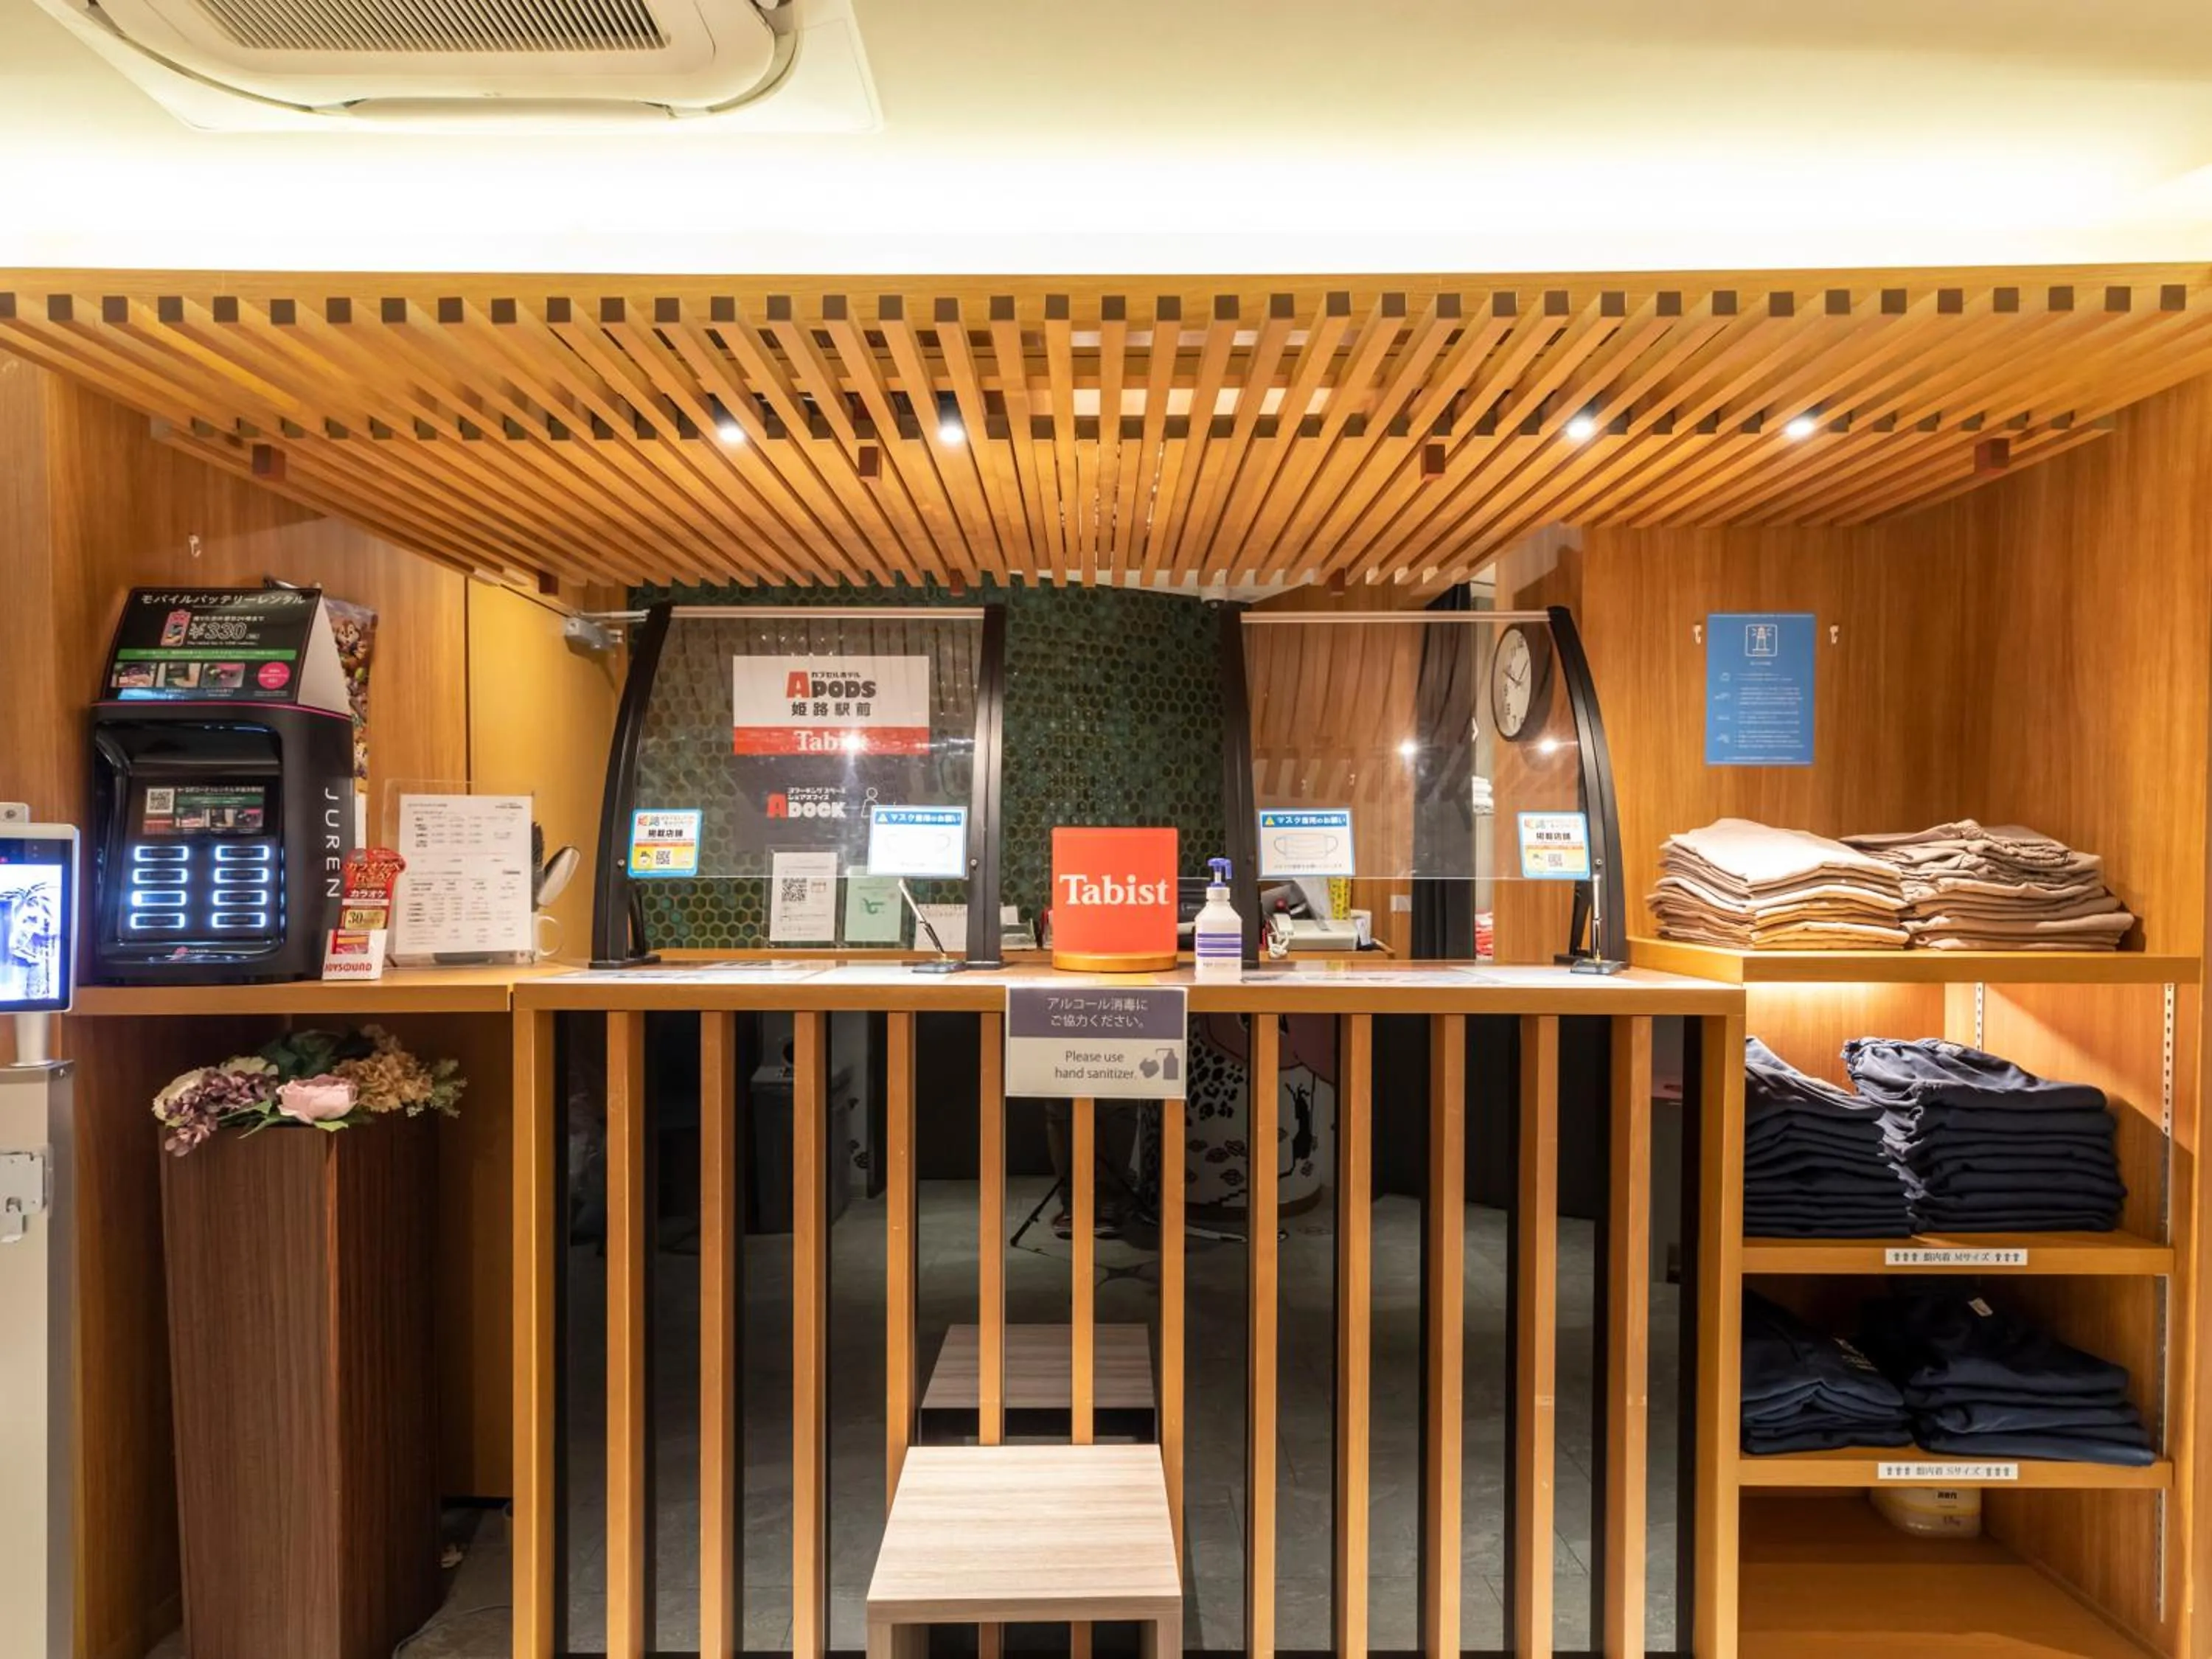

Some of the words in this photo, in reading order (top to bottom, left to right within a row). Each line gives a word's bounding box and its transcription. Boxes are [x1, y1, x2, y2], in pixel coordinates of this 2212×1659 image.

[142, 595, 306, 605] モバイルバッテリーレンタル
[792, 701, 871, 717] 姫路駅前
[325, 787, 340, 897] JUREN
[1059, 874, 1170, 905] Tabist
[1047, 998, 1148, 1012] アルコール消毒に
[1051, 1015, 1144, 1029] ご協力ください。
[1065, 1050, 1102, 1063] Please
[1105, 1054, 1124, 1062] use
[1055, 1066, 1084, 1079] hand
